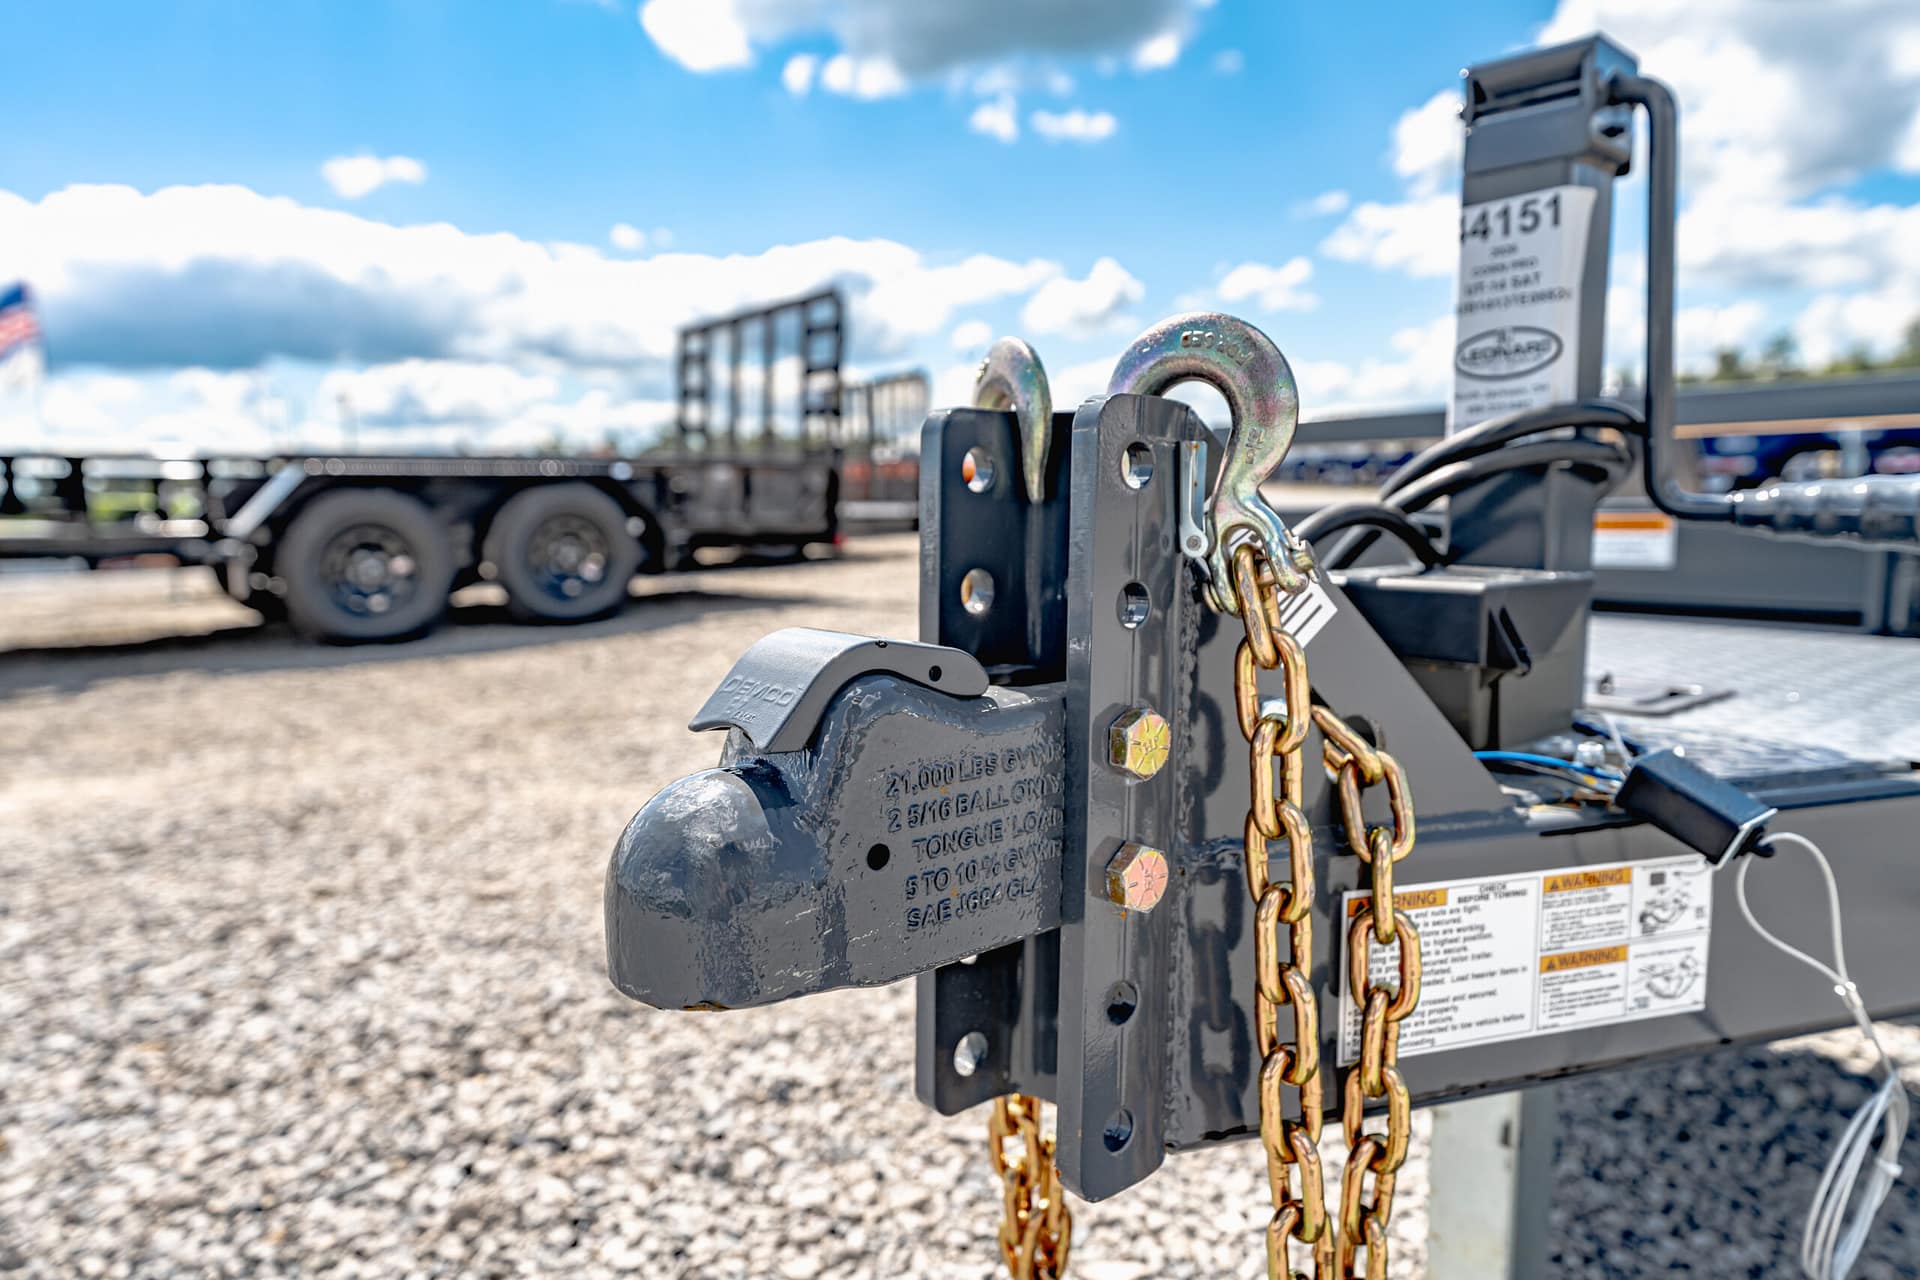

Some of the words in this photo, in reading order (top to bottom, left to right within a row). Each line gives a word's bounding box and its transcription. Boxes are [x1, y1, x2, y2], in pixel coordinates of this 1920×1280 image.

[1460, 194, 1562, 244] 4151
[720, 675, 797, 707] DEMCO
[958, 752, 999, 782] LBS
[887, 807, 903, 834] 2
[907, 796, 951, 829] 5/16
[955, 785, 1009, 818] BALL
[911, 818, 1004, 863] TONGUE
[905, 876, 919, 900] 5
[921, 867, 951, 896] TO
[1561, 869, 1624, 888] WARNING
[906, 897, 952, 933] SAE
[1393, 892, 1437, 908] RNING
